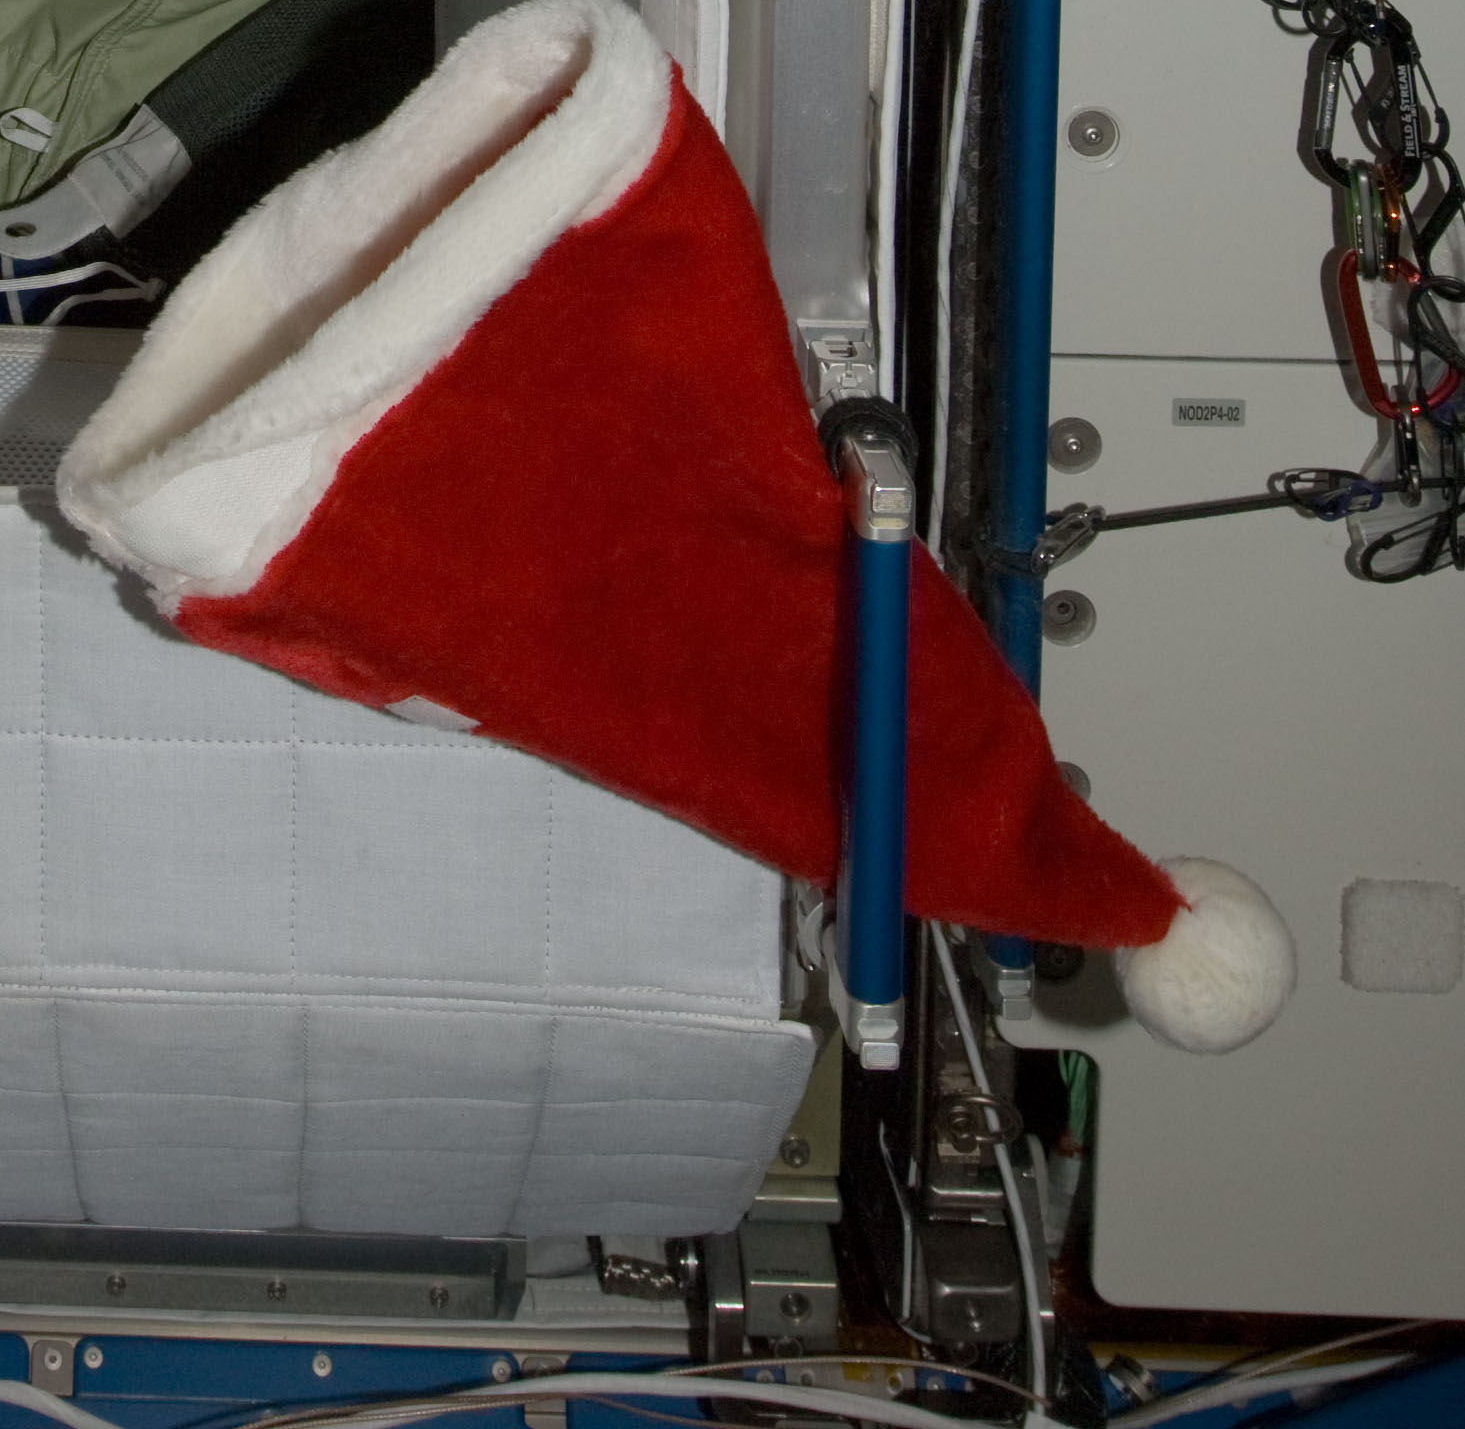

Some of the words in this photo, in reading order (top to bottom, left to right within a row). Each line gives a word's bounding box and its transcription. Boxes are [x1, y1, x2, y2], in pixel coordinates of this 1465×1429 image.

[1399, 65, 1411, 111] STREAM
[1404, 111, 1414, 124] &
[1404, 125, 1415, 157] FIELD
[1177, 405, 1241, 423] NOD2P4-02
